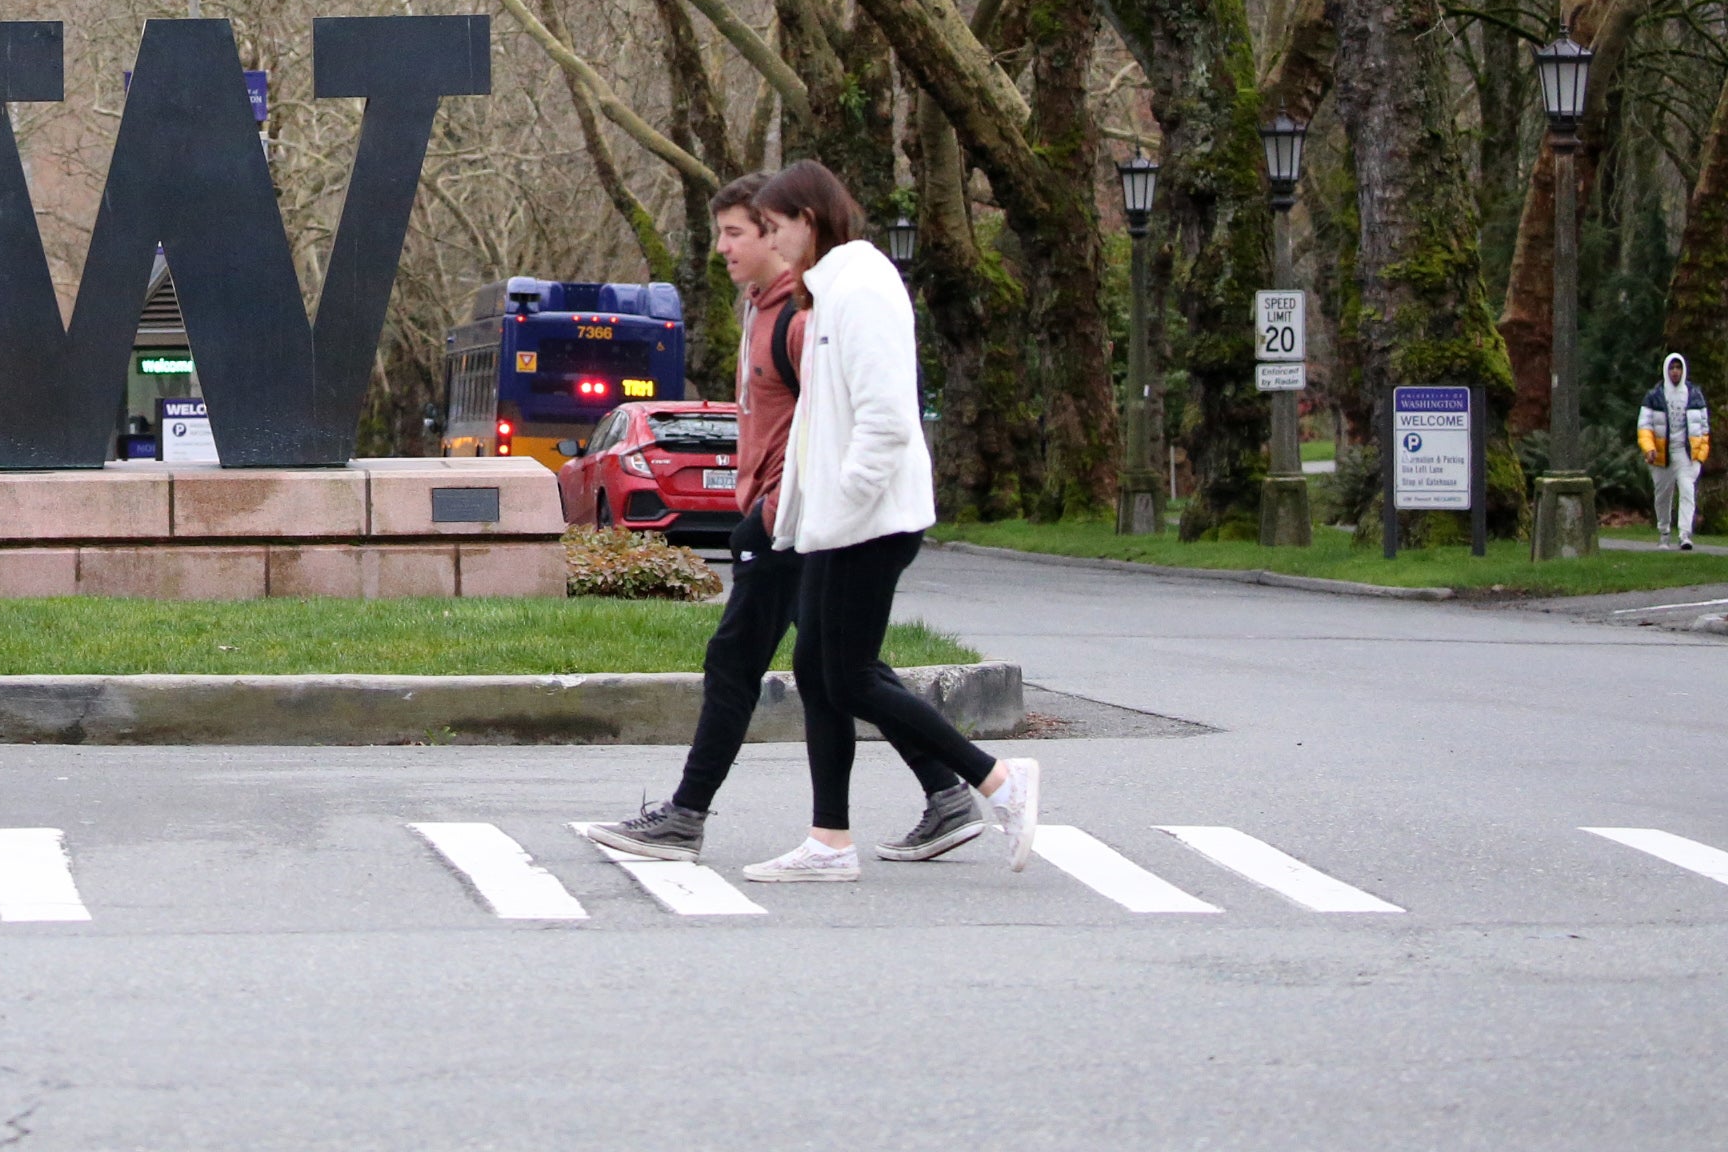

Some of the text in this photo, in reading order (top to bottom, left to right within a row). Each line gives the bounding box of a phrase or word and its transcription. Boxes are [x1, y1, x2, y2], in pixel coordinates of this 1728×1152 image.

[1264, 297, 1296, 309] SPEED
[1267, 311, 1292, 322] LIMIT
[577, 326, 613, 339] 7366
[1265, 326, 1295, 352] 20
[1261, 367, 1299, 376] Enforced
[1261, 377, 1299, 387] by Radar
[1400, 400, 1464, 408] WASHINGTON
[1400, 415, 1464, 426] WELCOME
[1443, 456, 1465, 465] Parking
